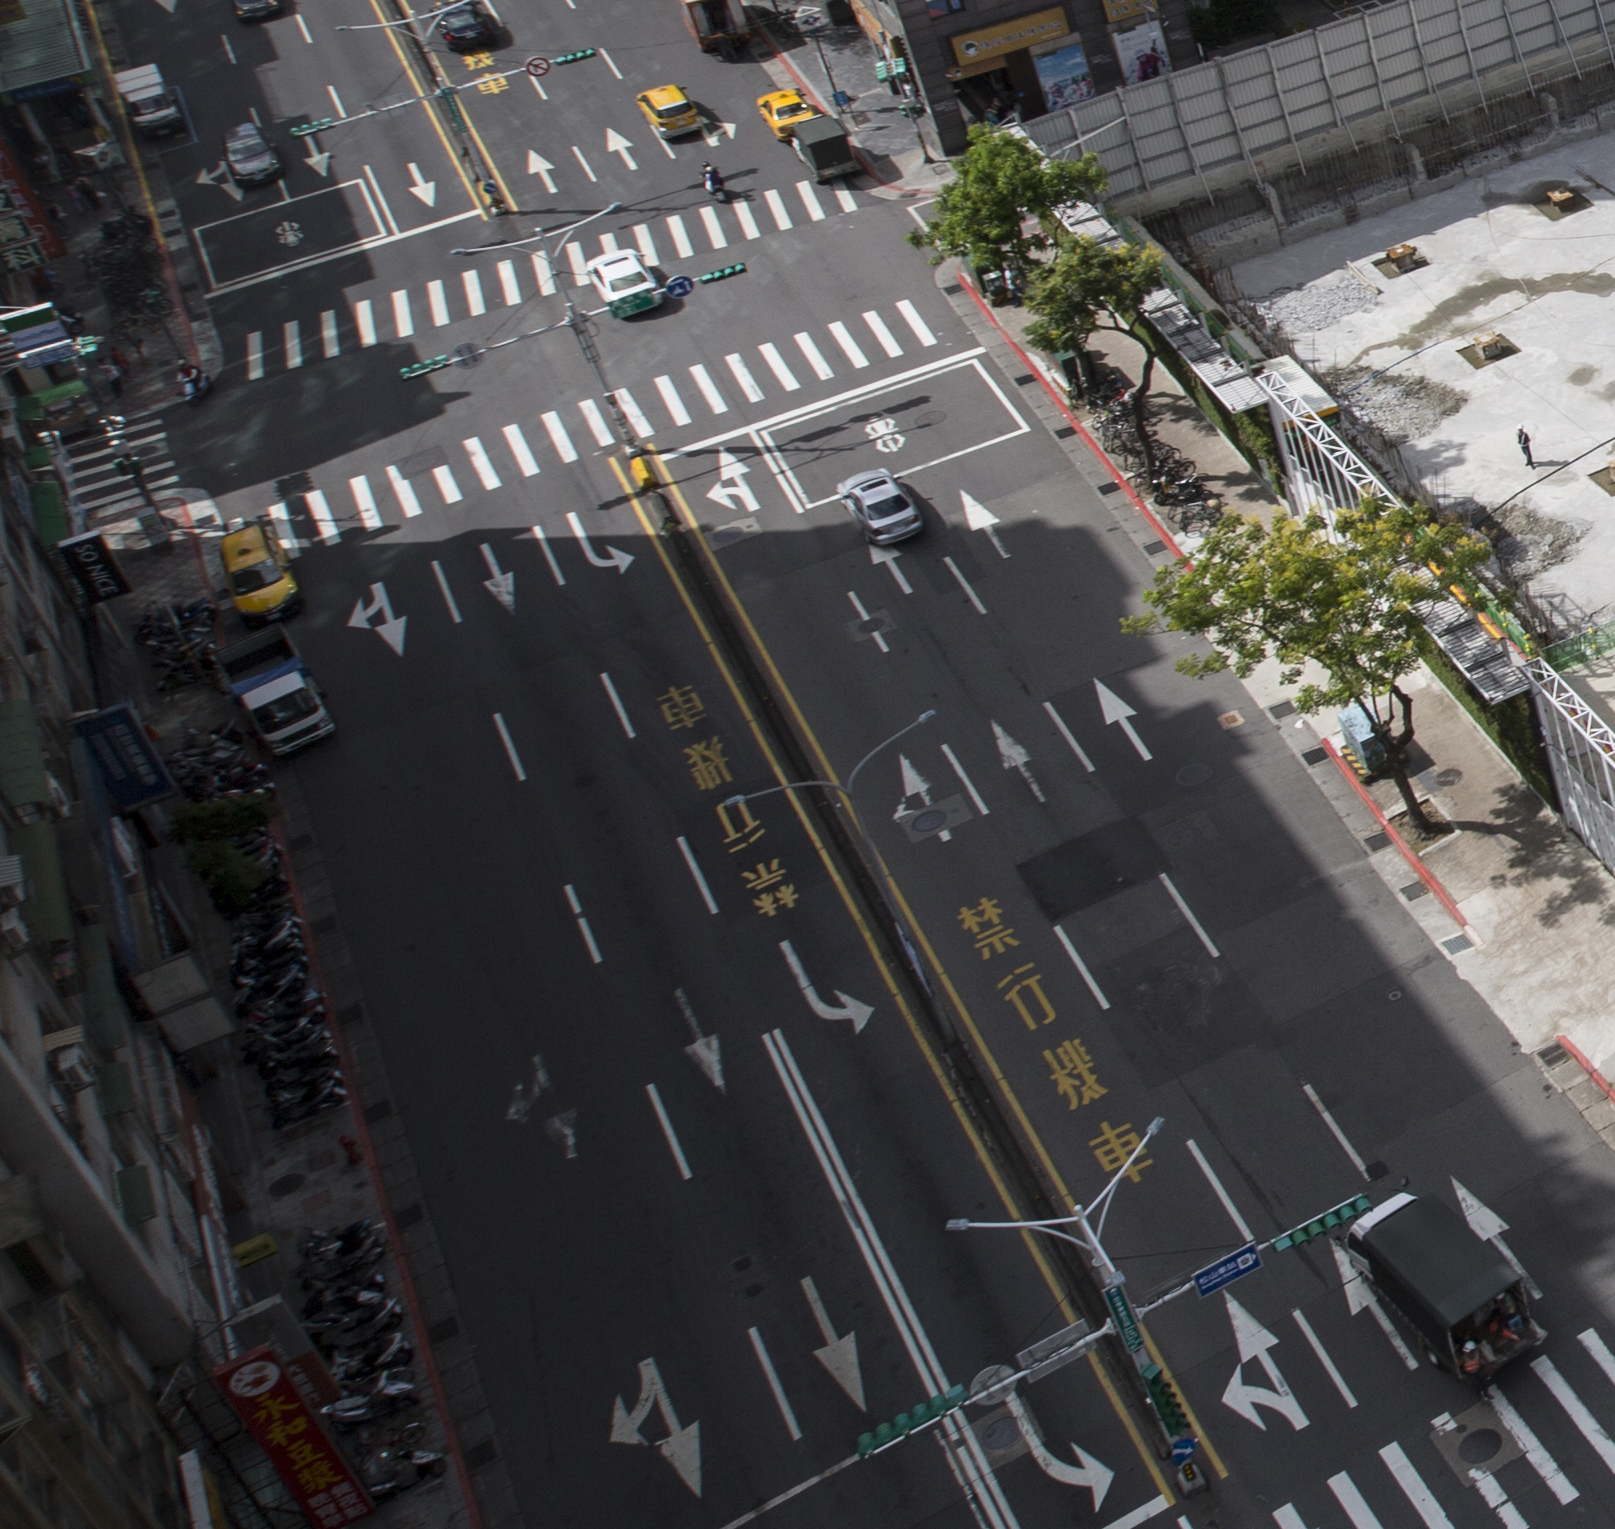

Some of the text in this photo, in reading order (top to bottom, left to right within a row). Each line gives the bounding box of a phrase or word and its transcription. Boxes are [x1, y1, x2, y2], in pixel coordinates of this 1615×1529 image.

[958, 896, 1154, 1183] 禁行機車
[253, 1392, 345, 1494] 永和豆漿
